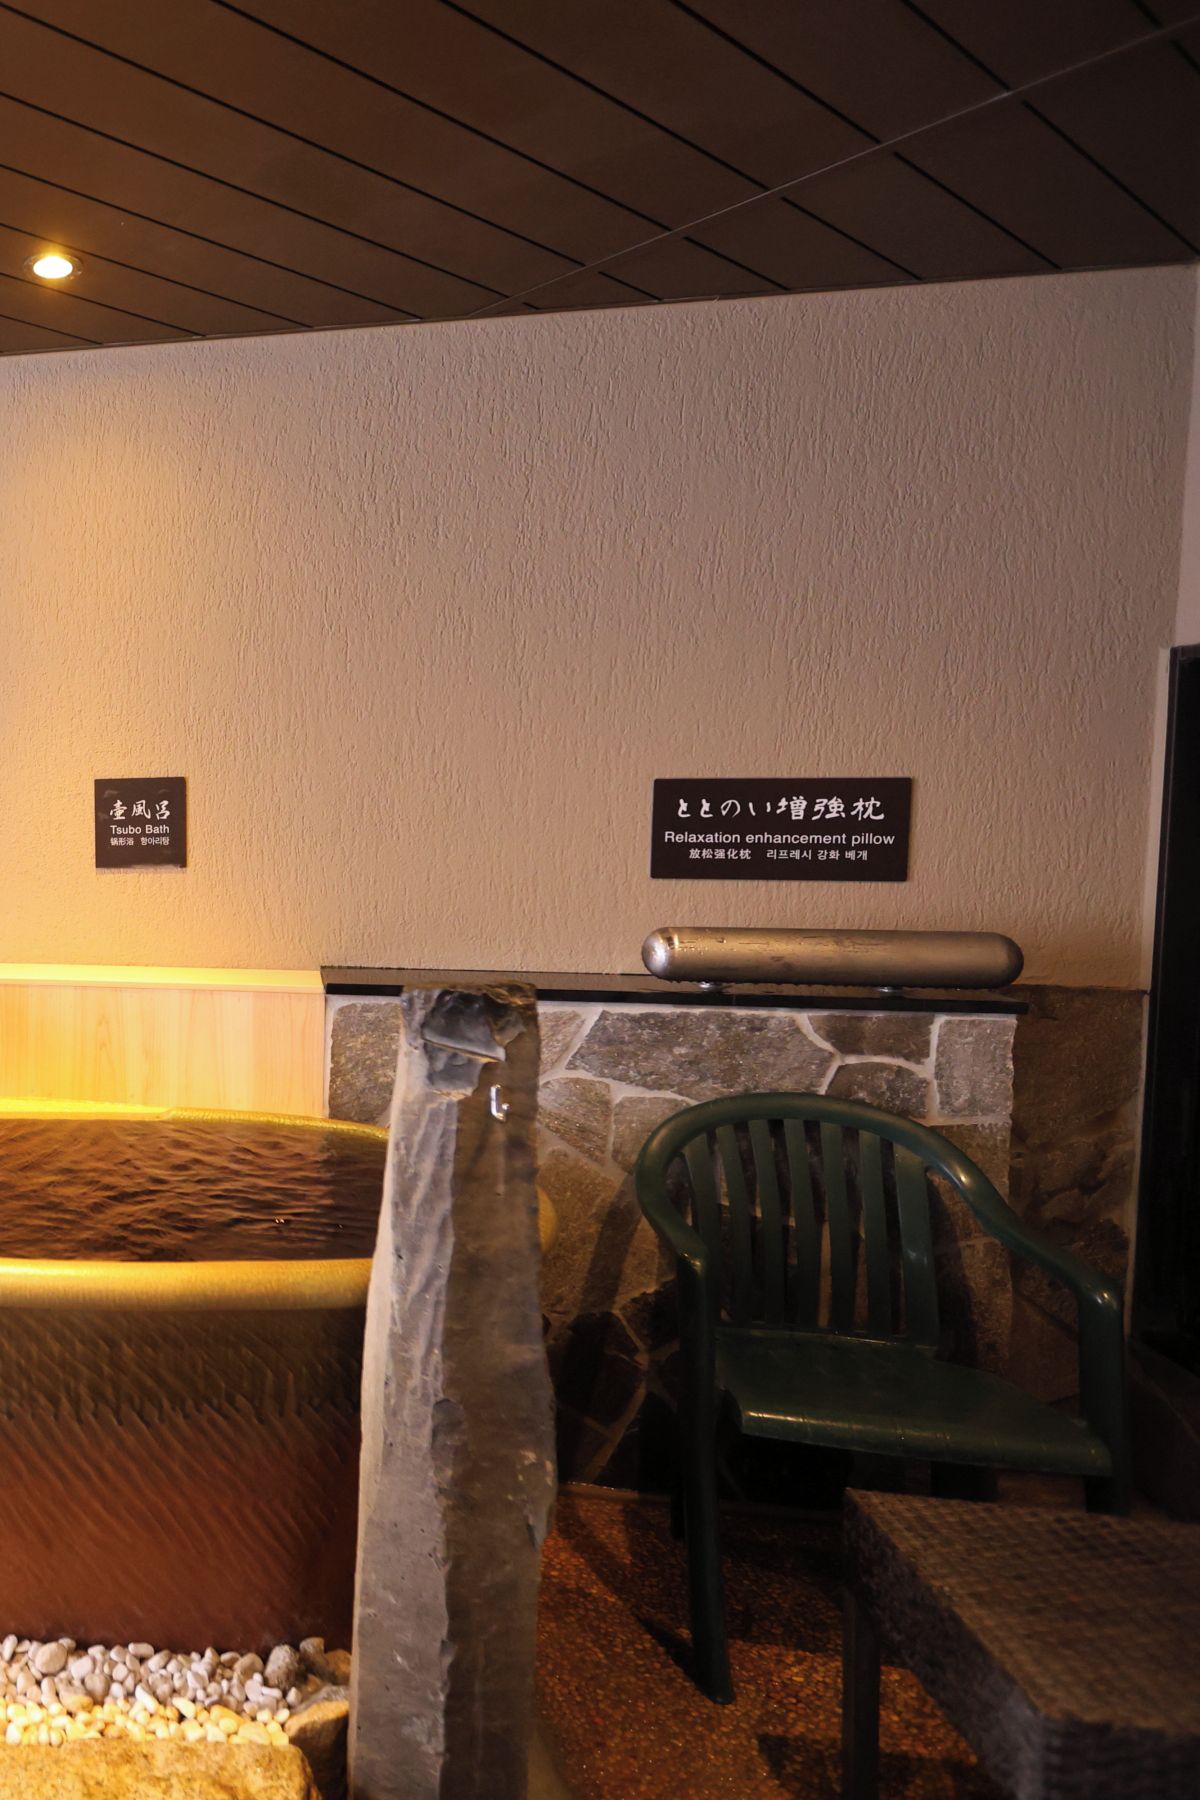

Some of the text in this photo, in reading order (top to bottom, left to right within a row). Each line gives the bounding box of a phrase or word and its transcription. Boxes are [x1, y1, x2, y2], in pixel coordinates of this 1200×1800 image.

[678, 796, 884, 820] ととのい増強枕
[110, 824, 170, 835] Tsubo Bath
[665, 831, 894, 846] Relaxation enhancement pillow
[689, 848, 751, 859] 放松强化枕
[767, 850, 867, 860] 리프레시 강화 베개
